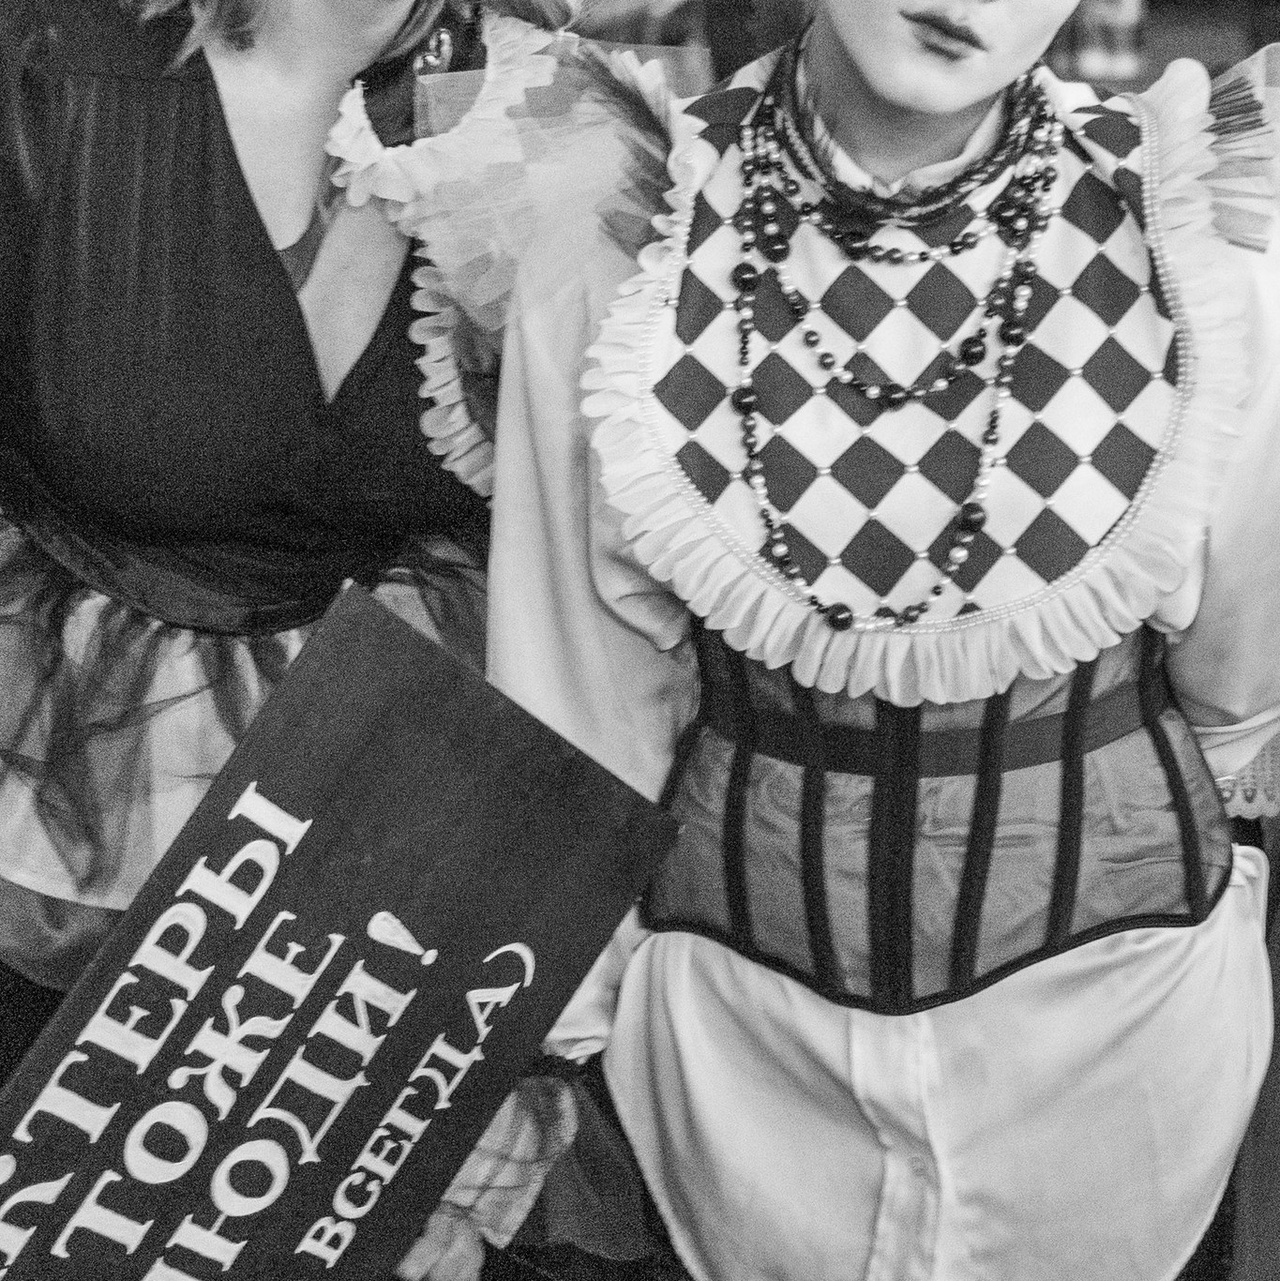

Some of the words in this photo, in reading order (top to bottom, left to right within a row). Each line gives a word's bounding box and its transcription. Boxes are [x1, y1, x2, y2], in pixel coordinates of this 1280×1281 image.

[0, 780, 313, 1280] КТЕРЫ
[50, 910, 346, 1259] ТОЖЕ
[294, 942, 536, 1270] ВСЕГДА)
